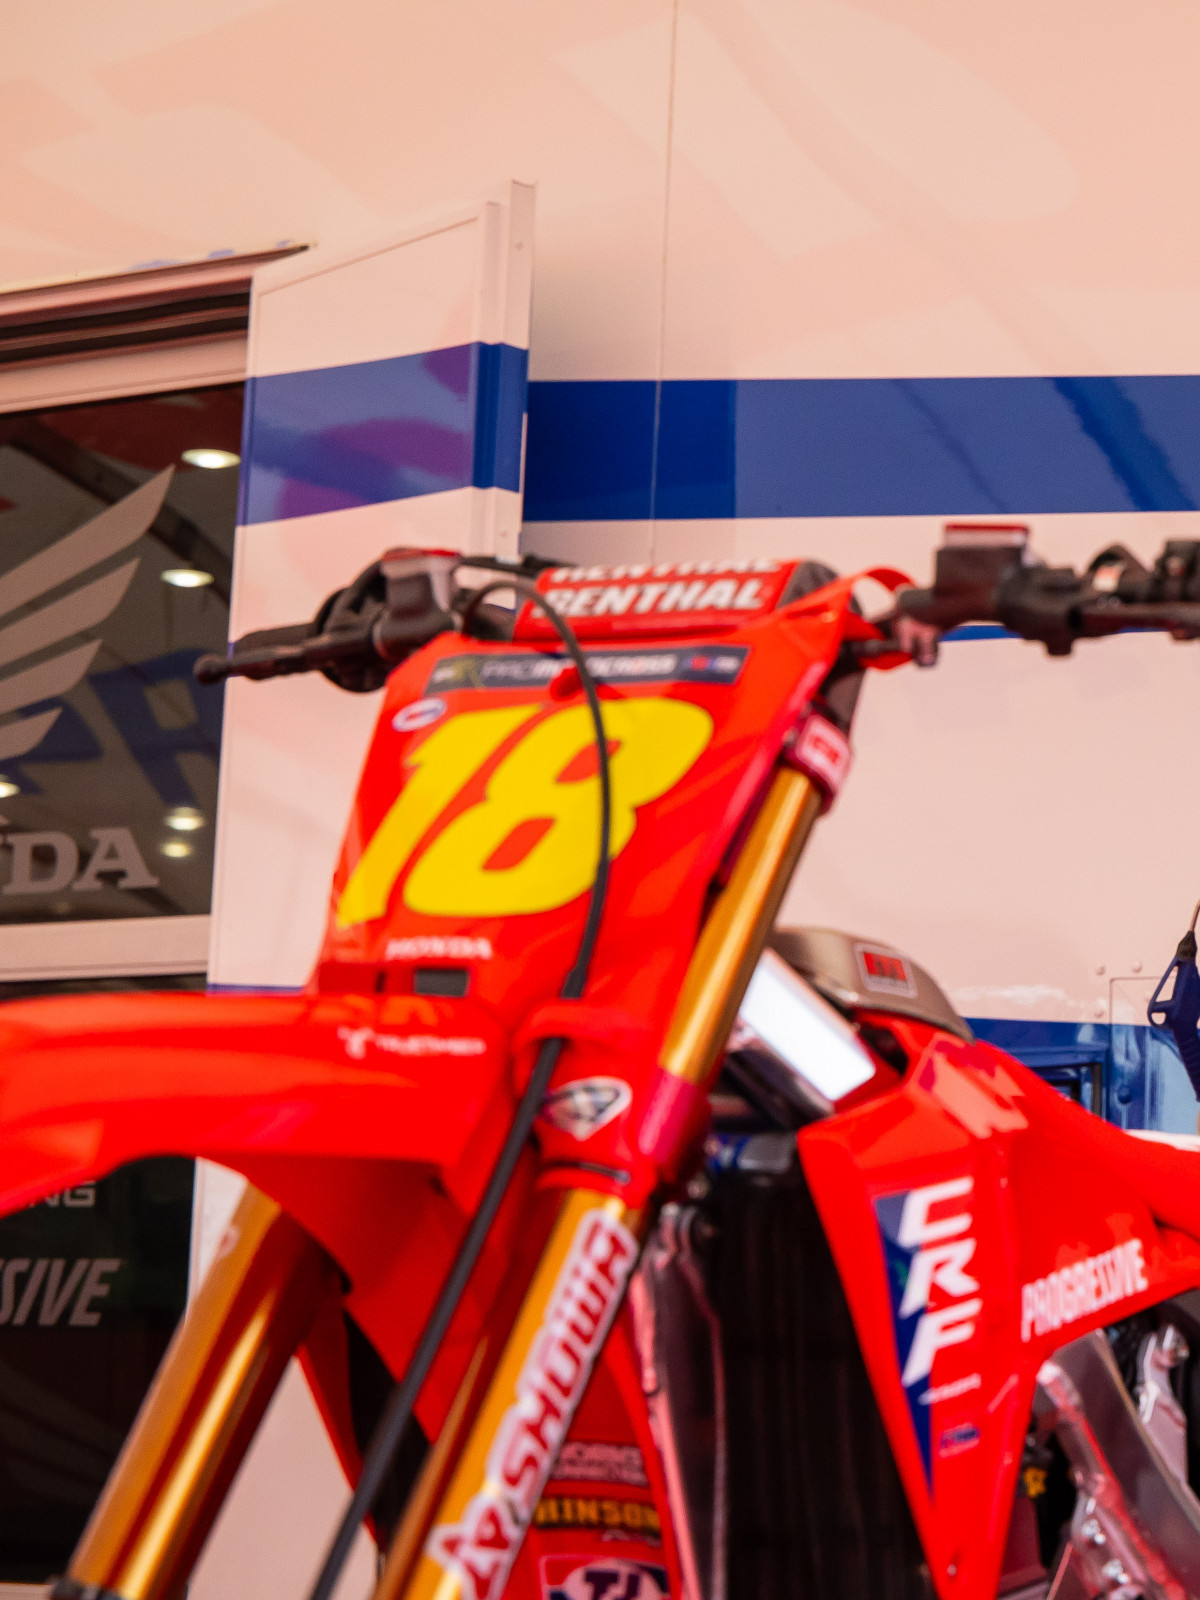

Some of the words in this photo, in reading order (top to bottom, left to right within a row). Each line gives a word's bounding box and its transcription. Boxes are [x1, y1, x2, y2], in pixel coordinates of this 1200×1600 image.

[0, 825, 161, 896] DA
[335, 697, 715, 927] 18
[0, 1256, 122, 1327] SIVE
[497, 1210, 636, 1510] SHOWA
[897, 1175, 983, 1389] CRF
